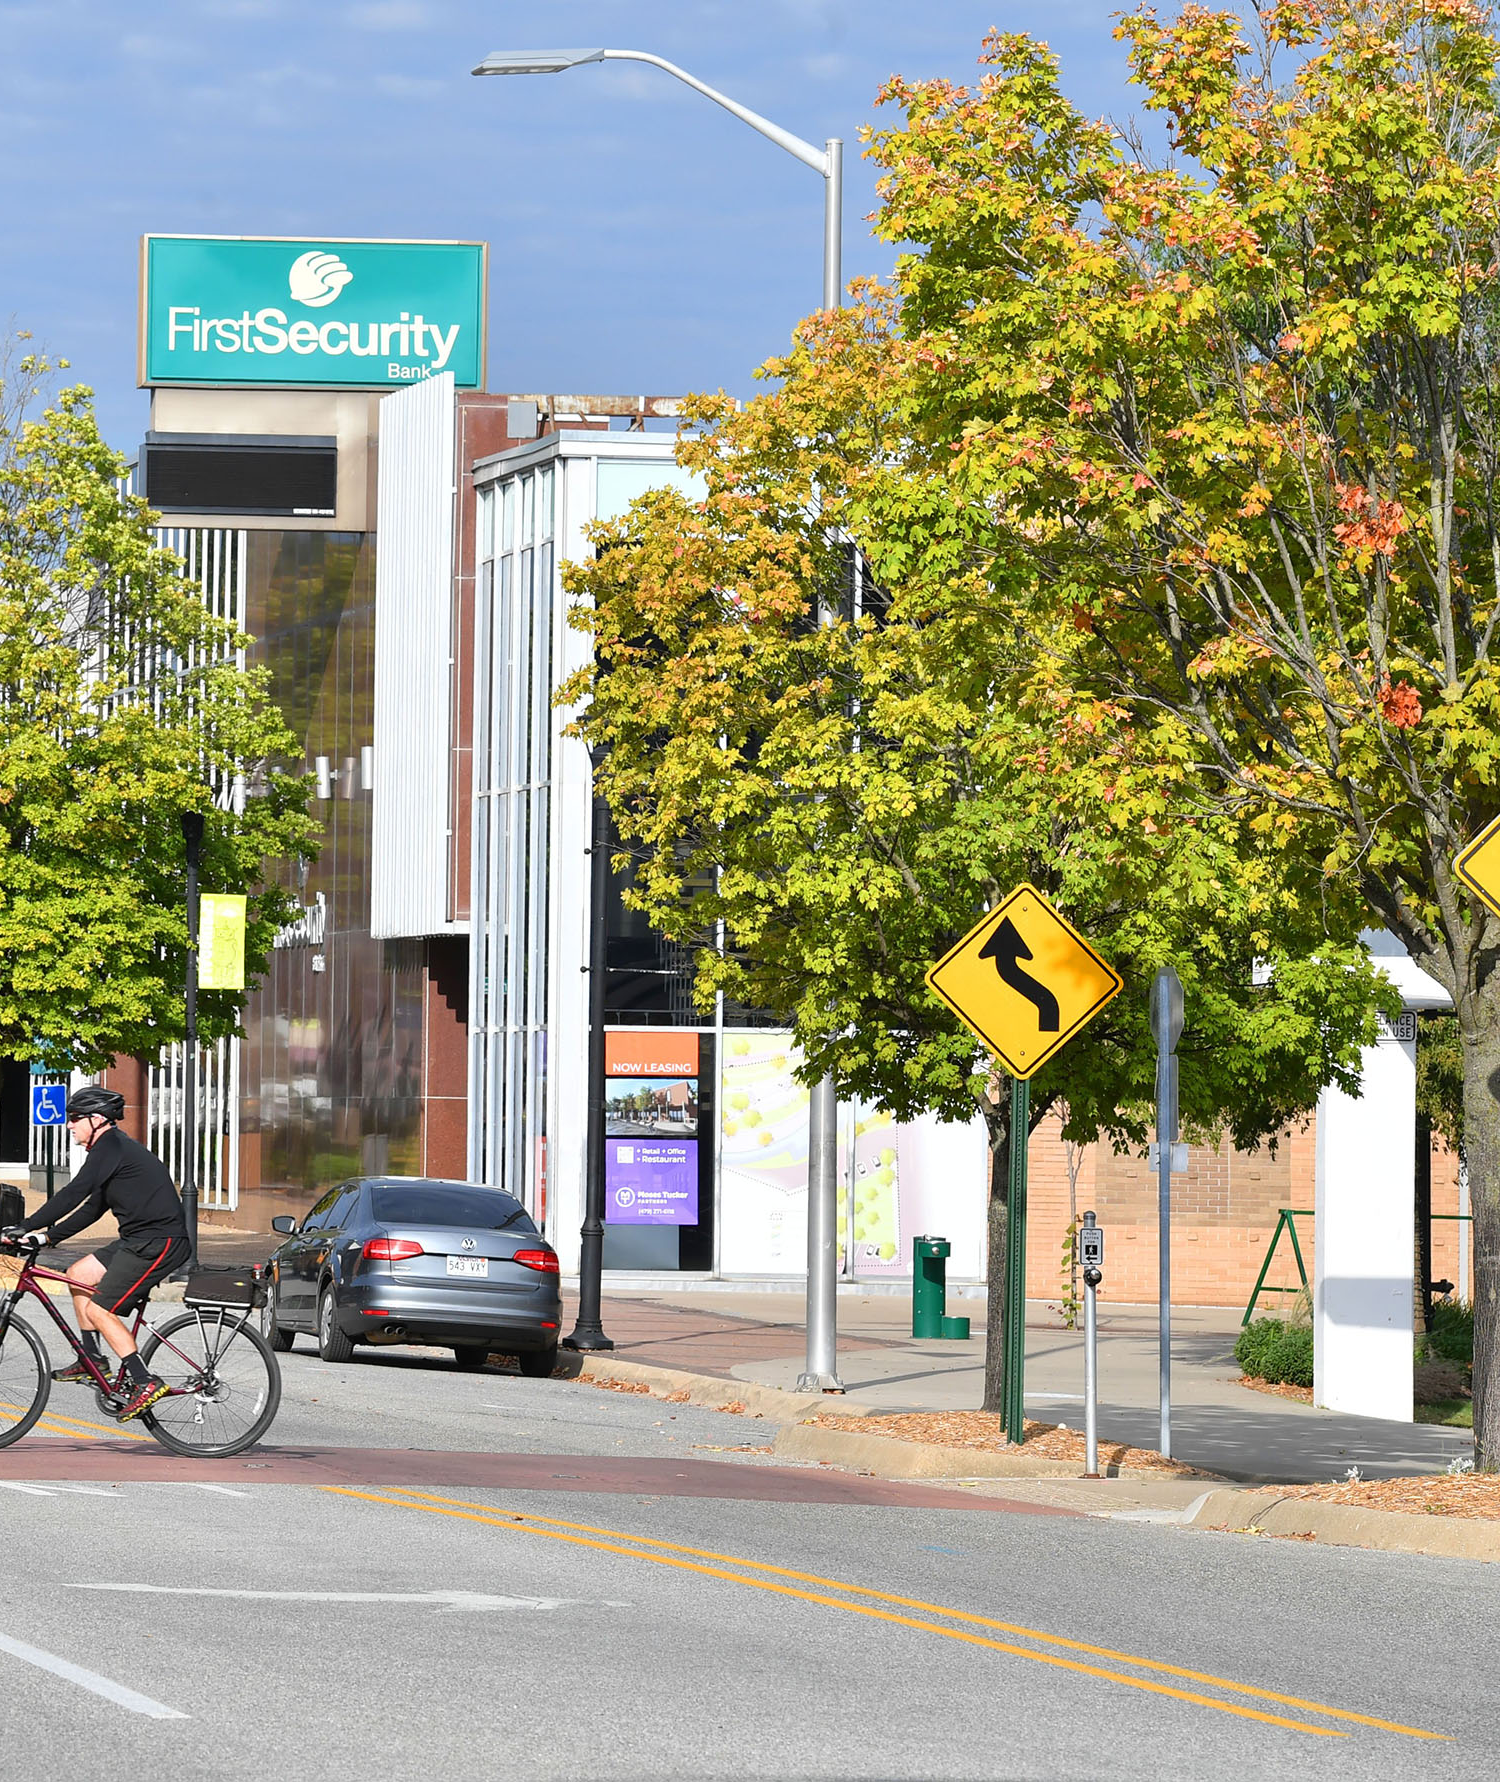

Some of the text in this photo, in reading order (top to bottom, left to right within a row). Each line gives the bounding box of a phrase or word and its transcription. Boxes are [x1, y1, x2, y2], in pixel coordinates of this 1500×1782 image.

[168, 306, 460, 369] FirstSecurity
[388, 363, 432, 379] Bank
[1393, 1027, 1411, 1038] USE
[612, 1063, 692, 1073] NOW LEASING
[642, 1156, 686, 1164] Restaurant
[449, 1261, 486, 1273] 543 VXY
